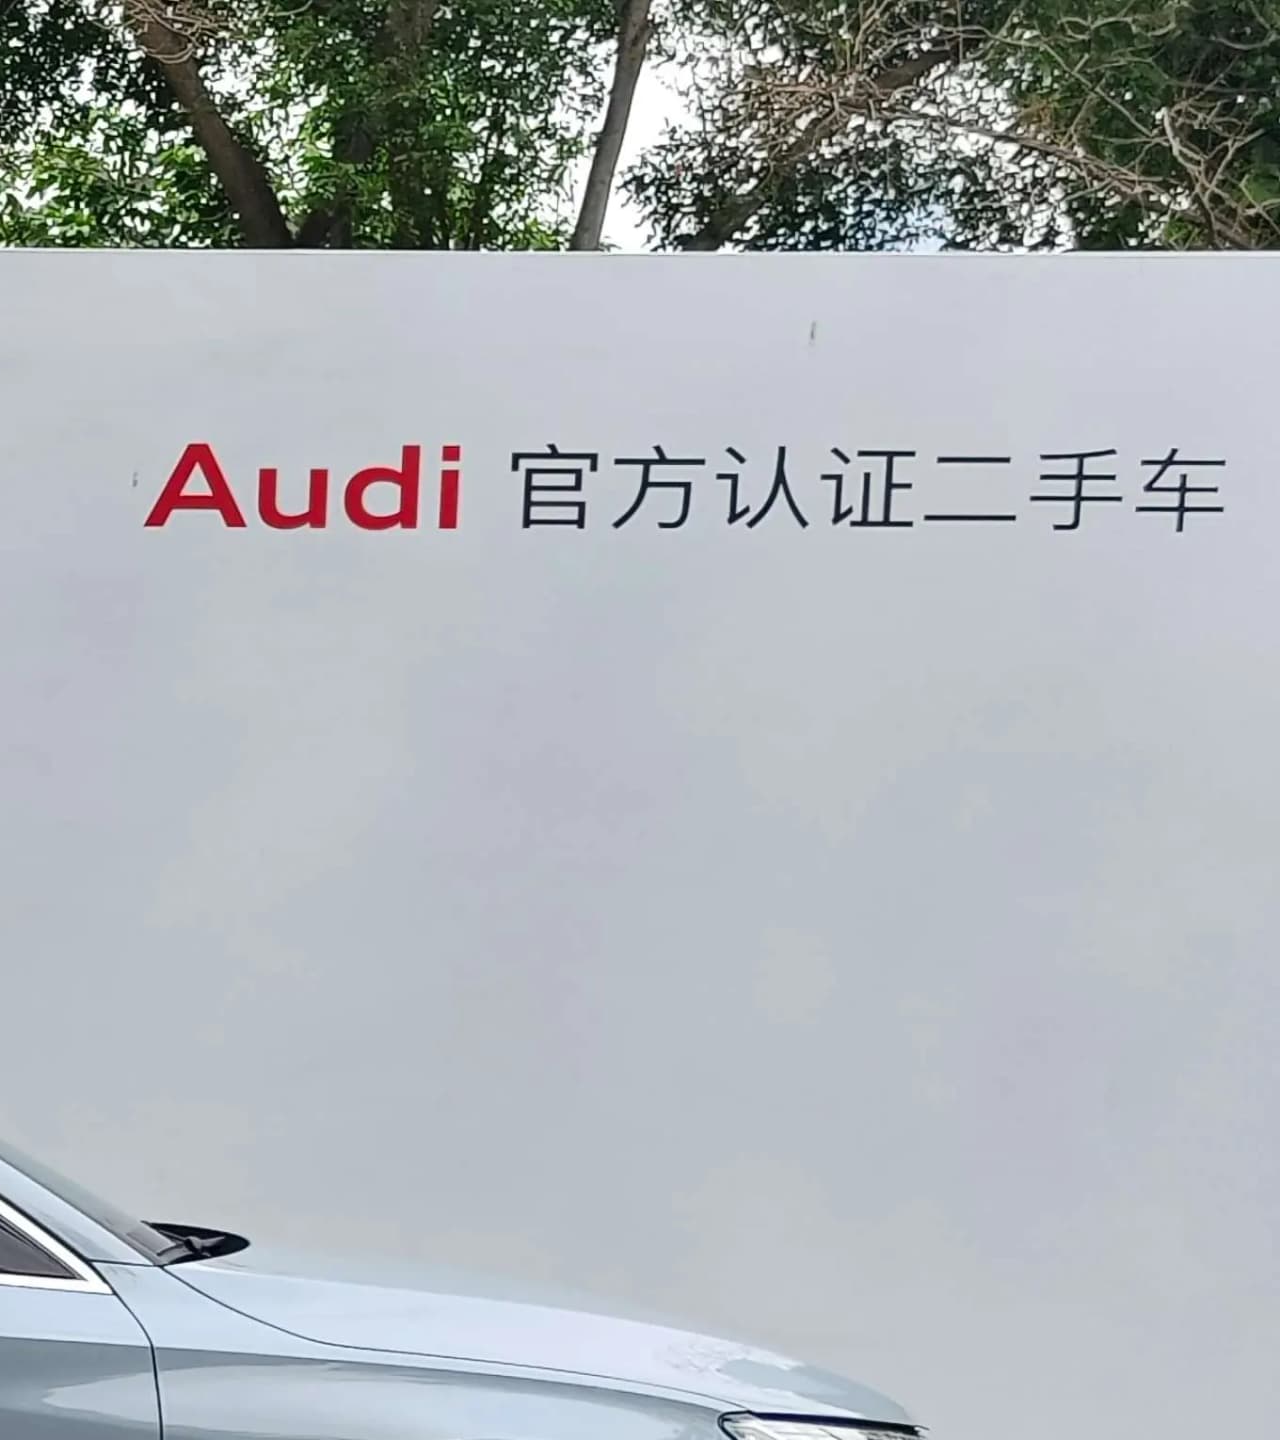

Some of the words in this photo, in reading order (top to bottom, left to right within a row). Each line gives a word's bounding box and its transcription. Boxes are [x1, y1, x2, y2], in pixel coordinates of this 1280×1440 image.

[144, 442, 461, 531] Audi
[510, 443, 1227, 533] 官方认证二手车
